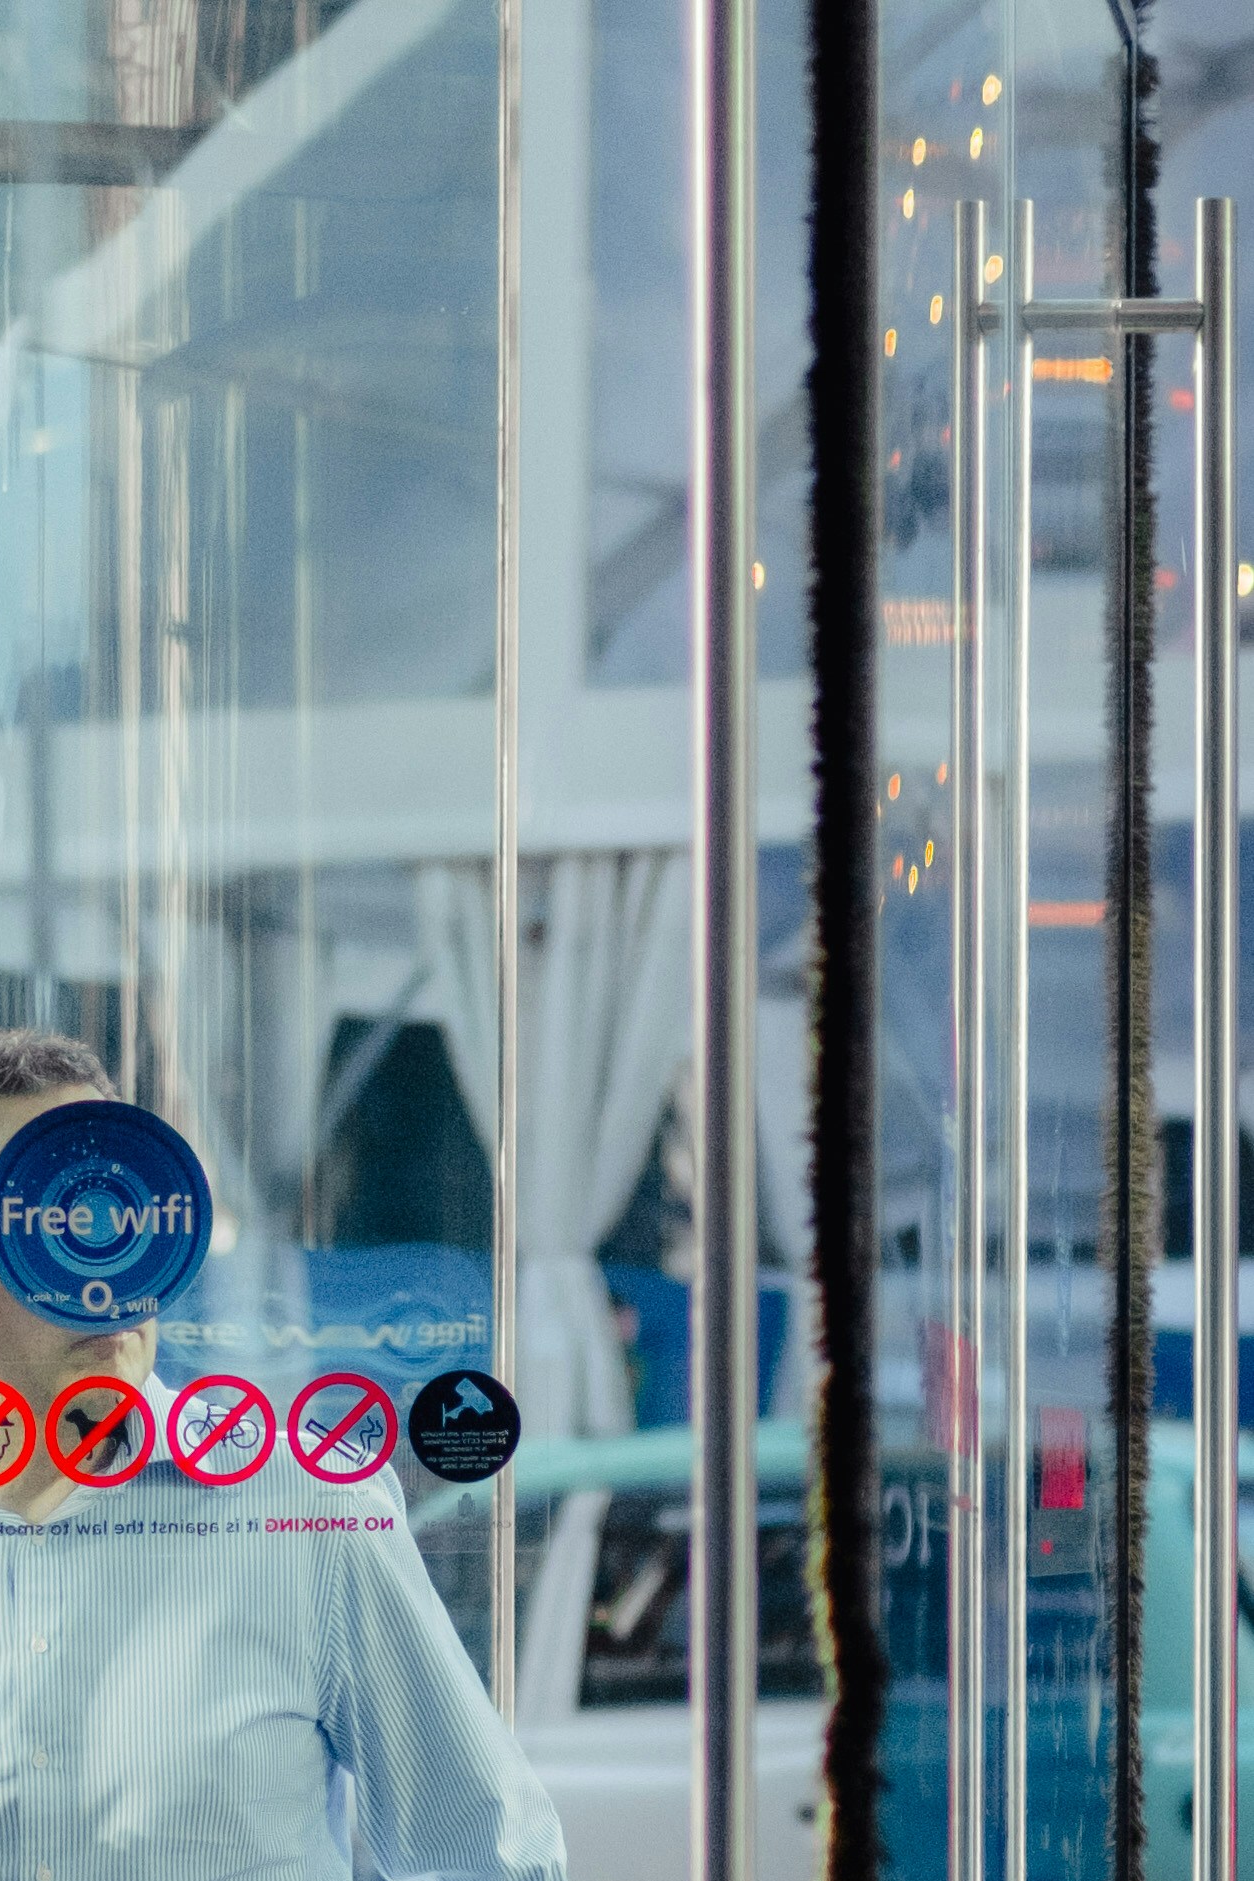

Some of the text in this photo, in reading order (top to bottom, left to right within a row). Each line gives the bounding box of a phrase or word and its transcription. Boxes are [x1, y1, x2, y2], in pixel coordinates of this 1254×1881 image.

[1, 1193, 193, 1236] Free wifi
[126, 1297, 158, 1312] wifi
